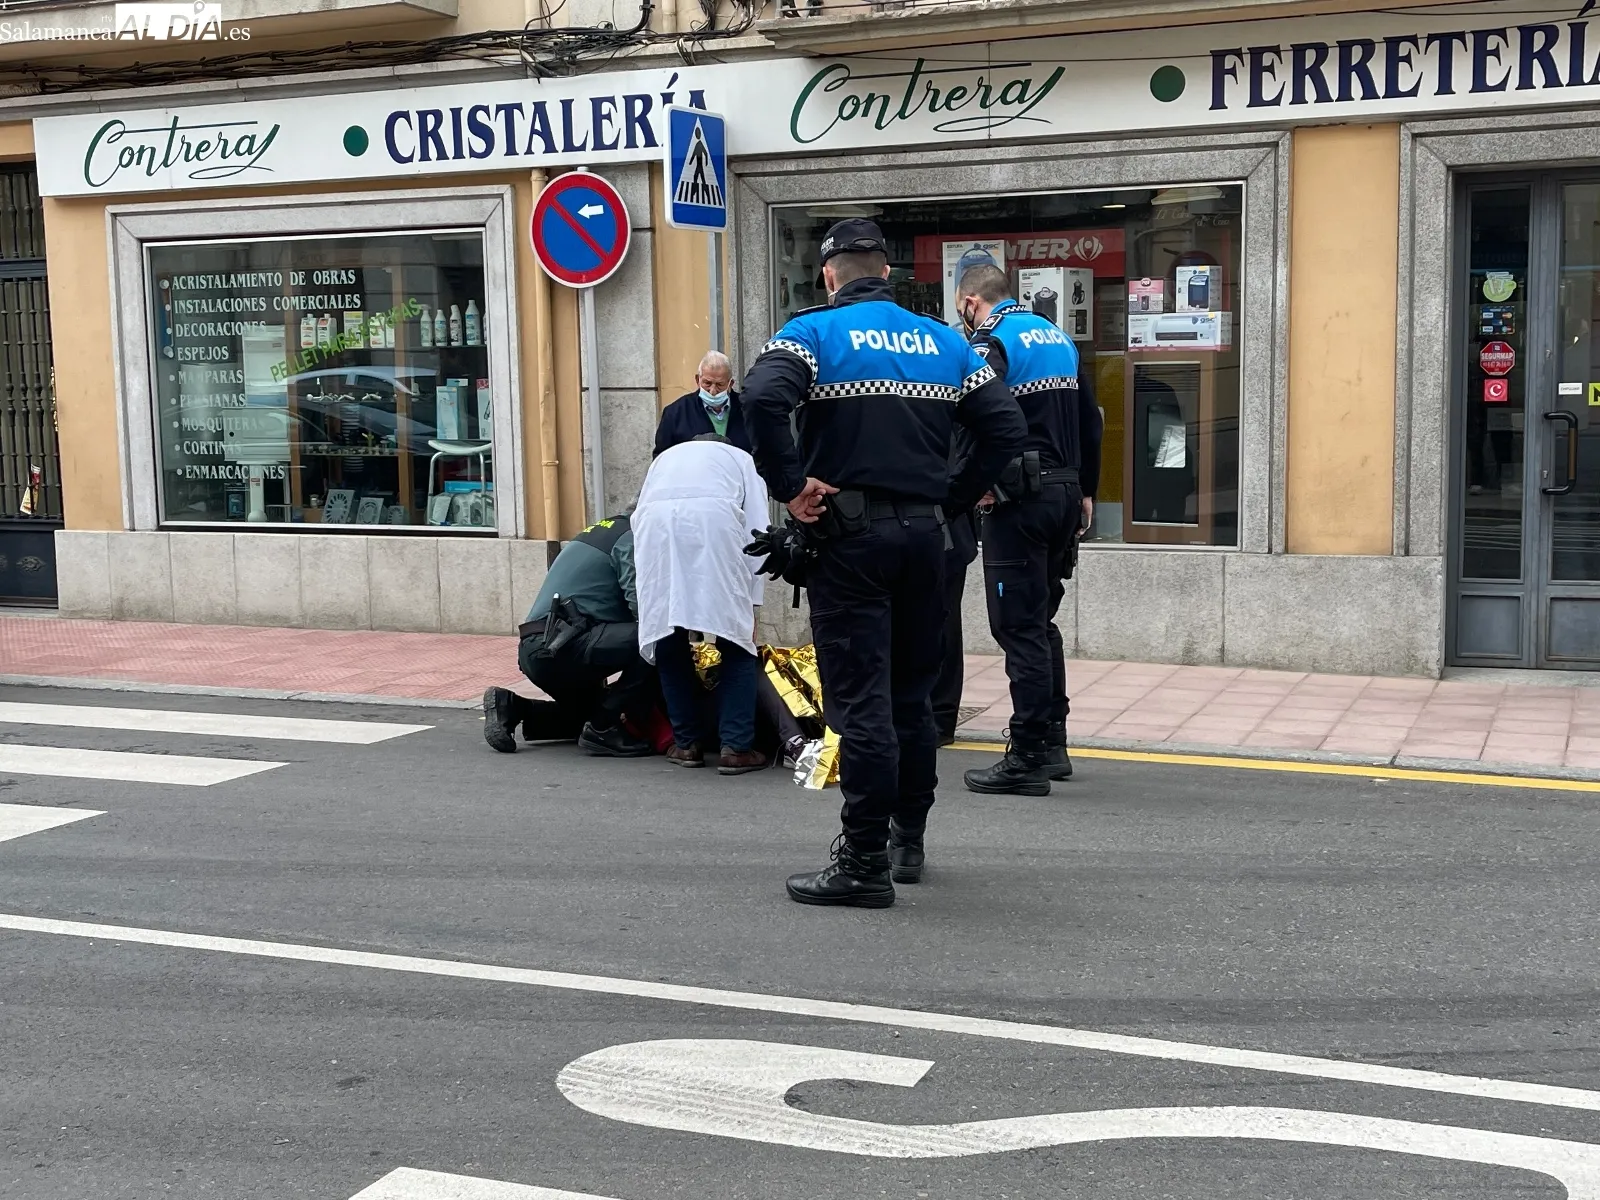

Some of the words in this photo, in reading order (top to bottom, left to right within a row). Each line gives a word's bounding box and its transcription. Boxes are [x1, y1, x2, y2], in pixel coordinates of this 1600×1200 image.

[1208, 0, 1600, 111] FERRETERÍ
[384, 72, 707, 165] CRISTALER
[172, 271, 283, 290] ACRISTALAMIENTO
[289, 271, 307, 286] DE
[313, 269, 356, 286] OBRAS
[174, 297, 267, 314] INSTALACIONES
[273, 294, 362, 311] COMERCIALES
[175, 321, 267, 338] DECORACIONES
[1018, 328, 1066, 349] POLIC
[848, 329, 940, 356] POLICÍA
[177, 346, 229, 361] ESPEJOS
[270, 347, 320, 382] PELLET
[319, 327, 361, 359] PARA
[178, 369, 244, 385] MAMPARAS
[180, 393, 247, 408] PEIANAS
[181, 417, 265, 433] MOSQUITERAS
[183, 440, 242, 455] CORTINAS
[185, 465, 286, 479] ENMARCACNES
